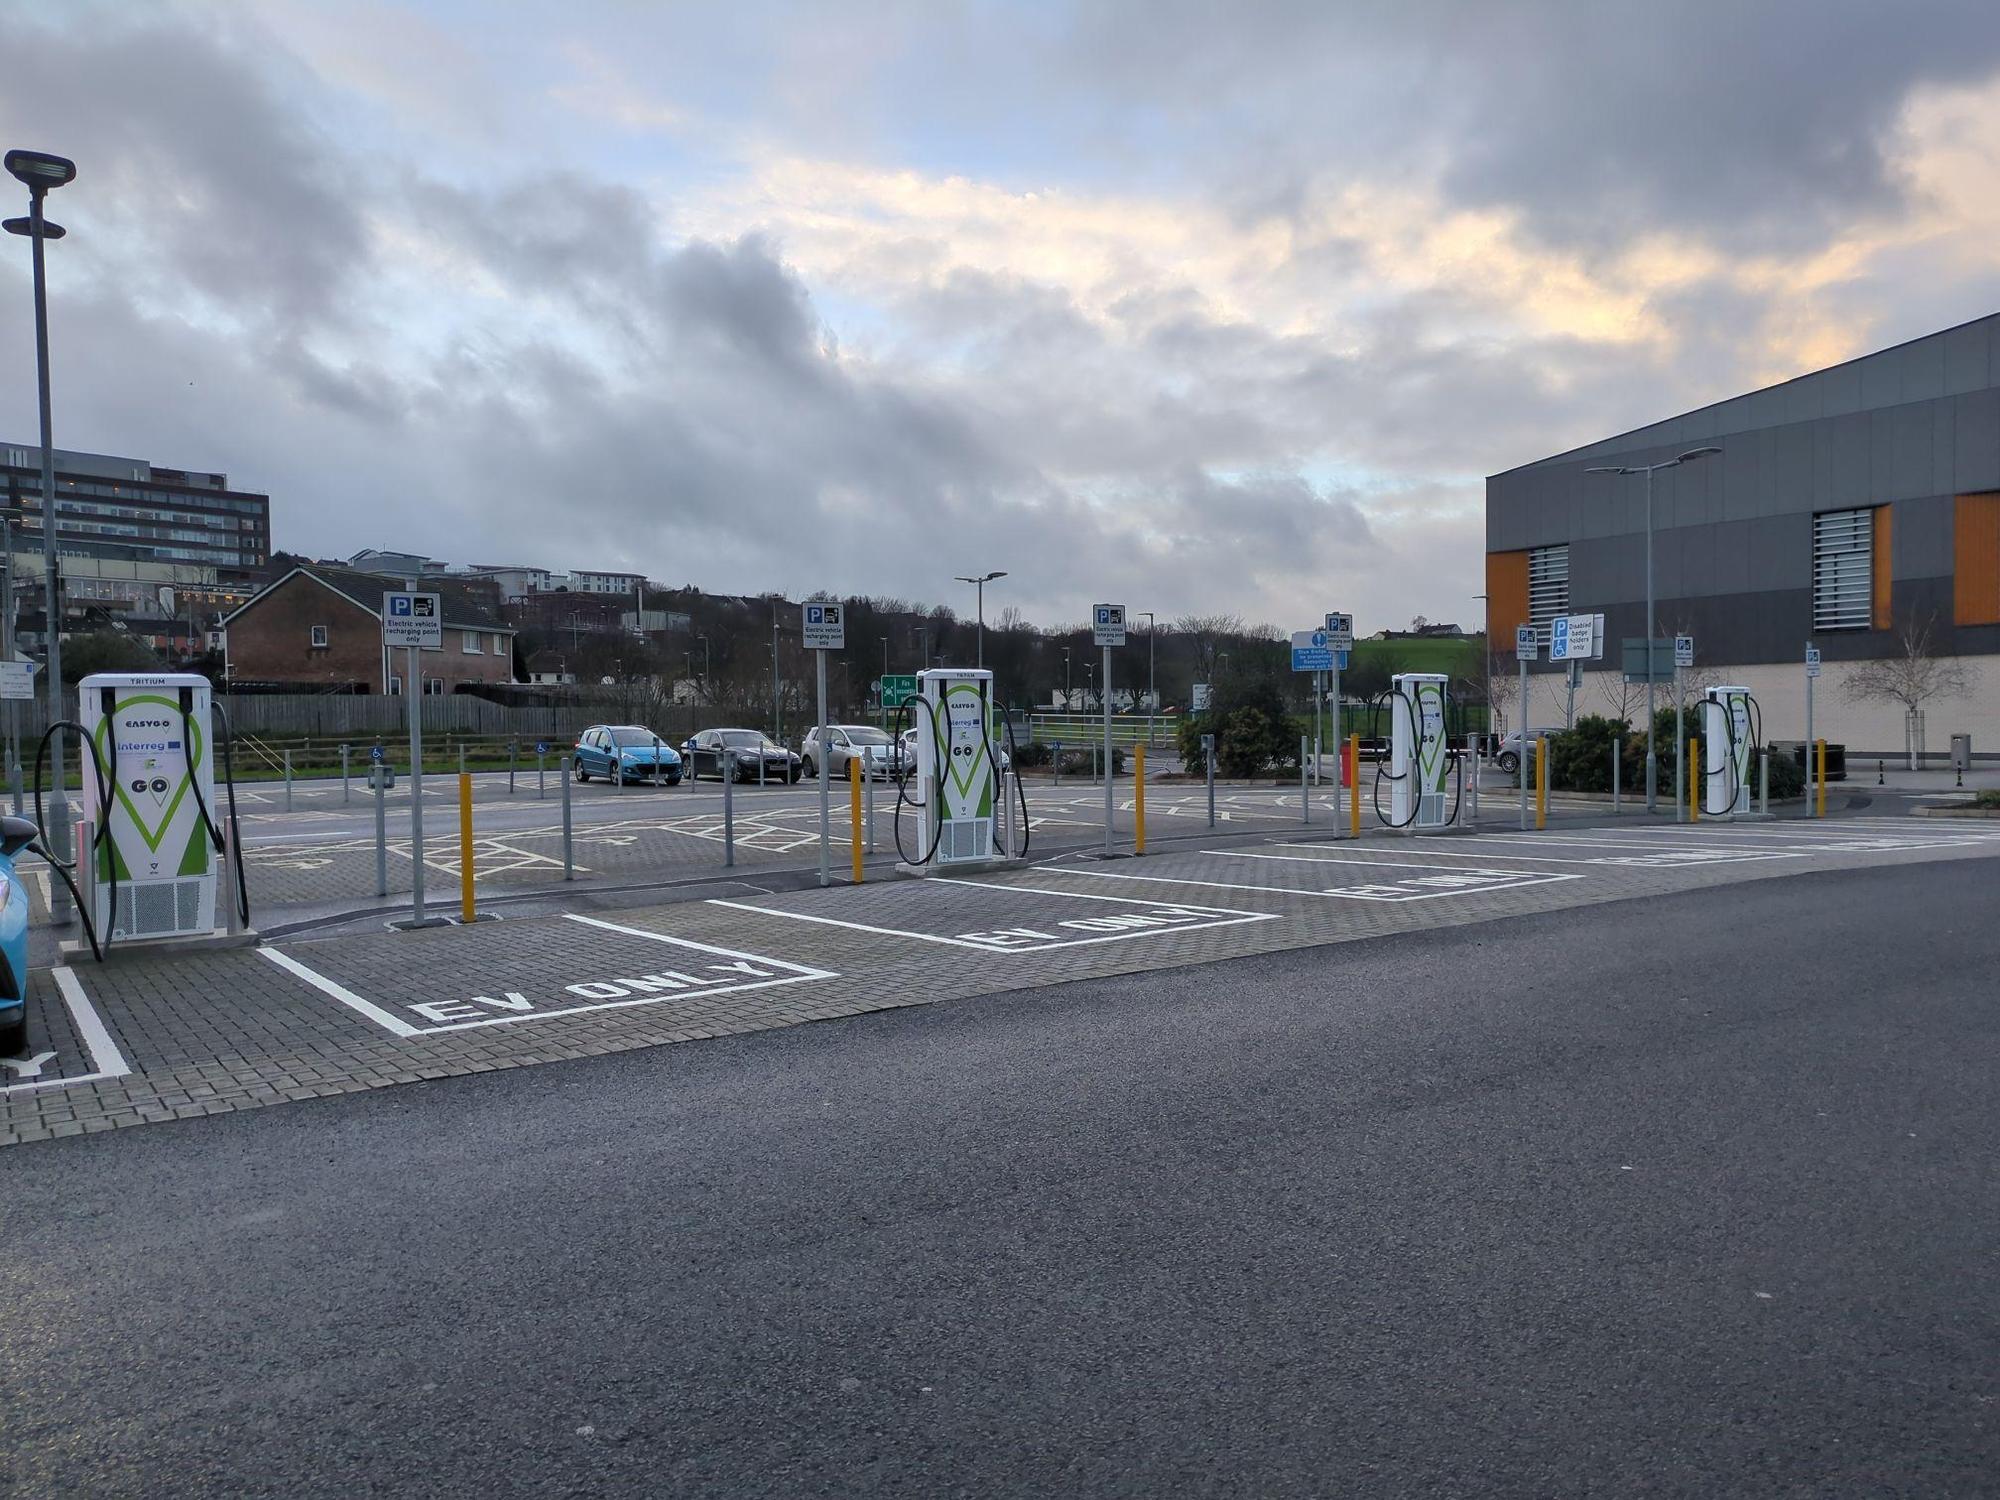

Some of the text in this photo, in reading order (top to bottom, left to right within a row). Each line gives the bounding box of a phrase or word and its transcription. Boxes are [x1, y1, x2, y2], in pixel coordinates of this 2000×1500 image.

[395, 598, 408, 615] P
[811, 609, 820, 622] P
[415, 620, 437, 628] vehicle
[1557, 621, 1566, 636] P
[1569, 621, 1592, 629] Disabled
[386, 628, 421, 636] recharging
[117, 741, 165, 751] Interreg
[131, 779, 168, 793] GO
[955, 908, 1223, 946] EV ONLY
[406, 961, 775, 1021] EV ONLY
